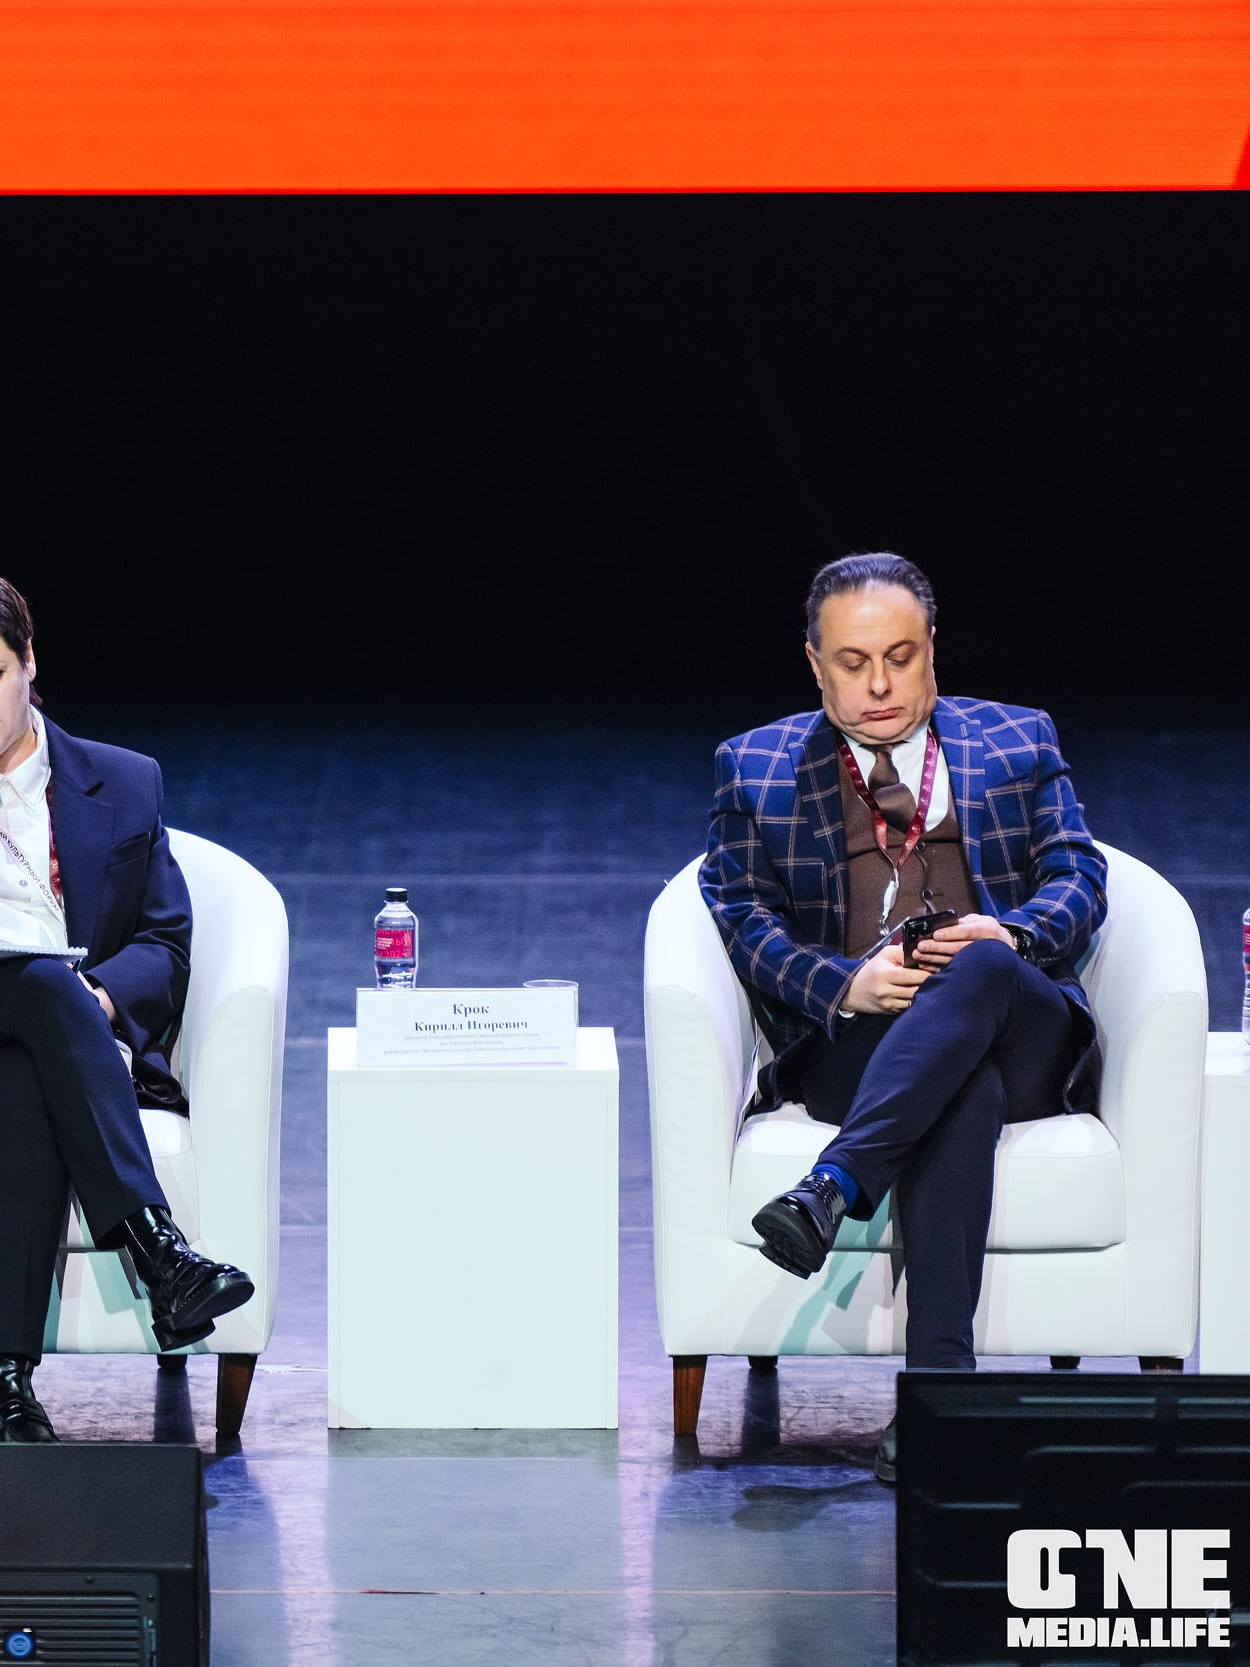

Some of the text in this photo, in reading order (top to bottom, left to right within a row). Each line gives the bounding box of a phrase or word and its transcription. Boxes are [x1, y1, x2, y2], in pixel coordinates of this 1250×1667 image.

[6, 840, 41, 883] КУЛЬТУРНЫЙ
[39, 883, 59, 911] ФОРУМ
[453, 1003, 490, 1018] Крок
[414, 1020, 528, 1034] Кирилл Игоревич
